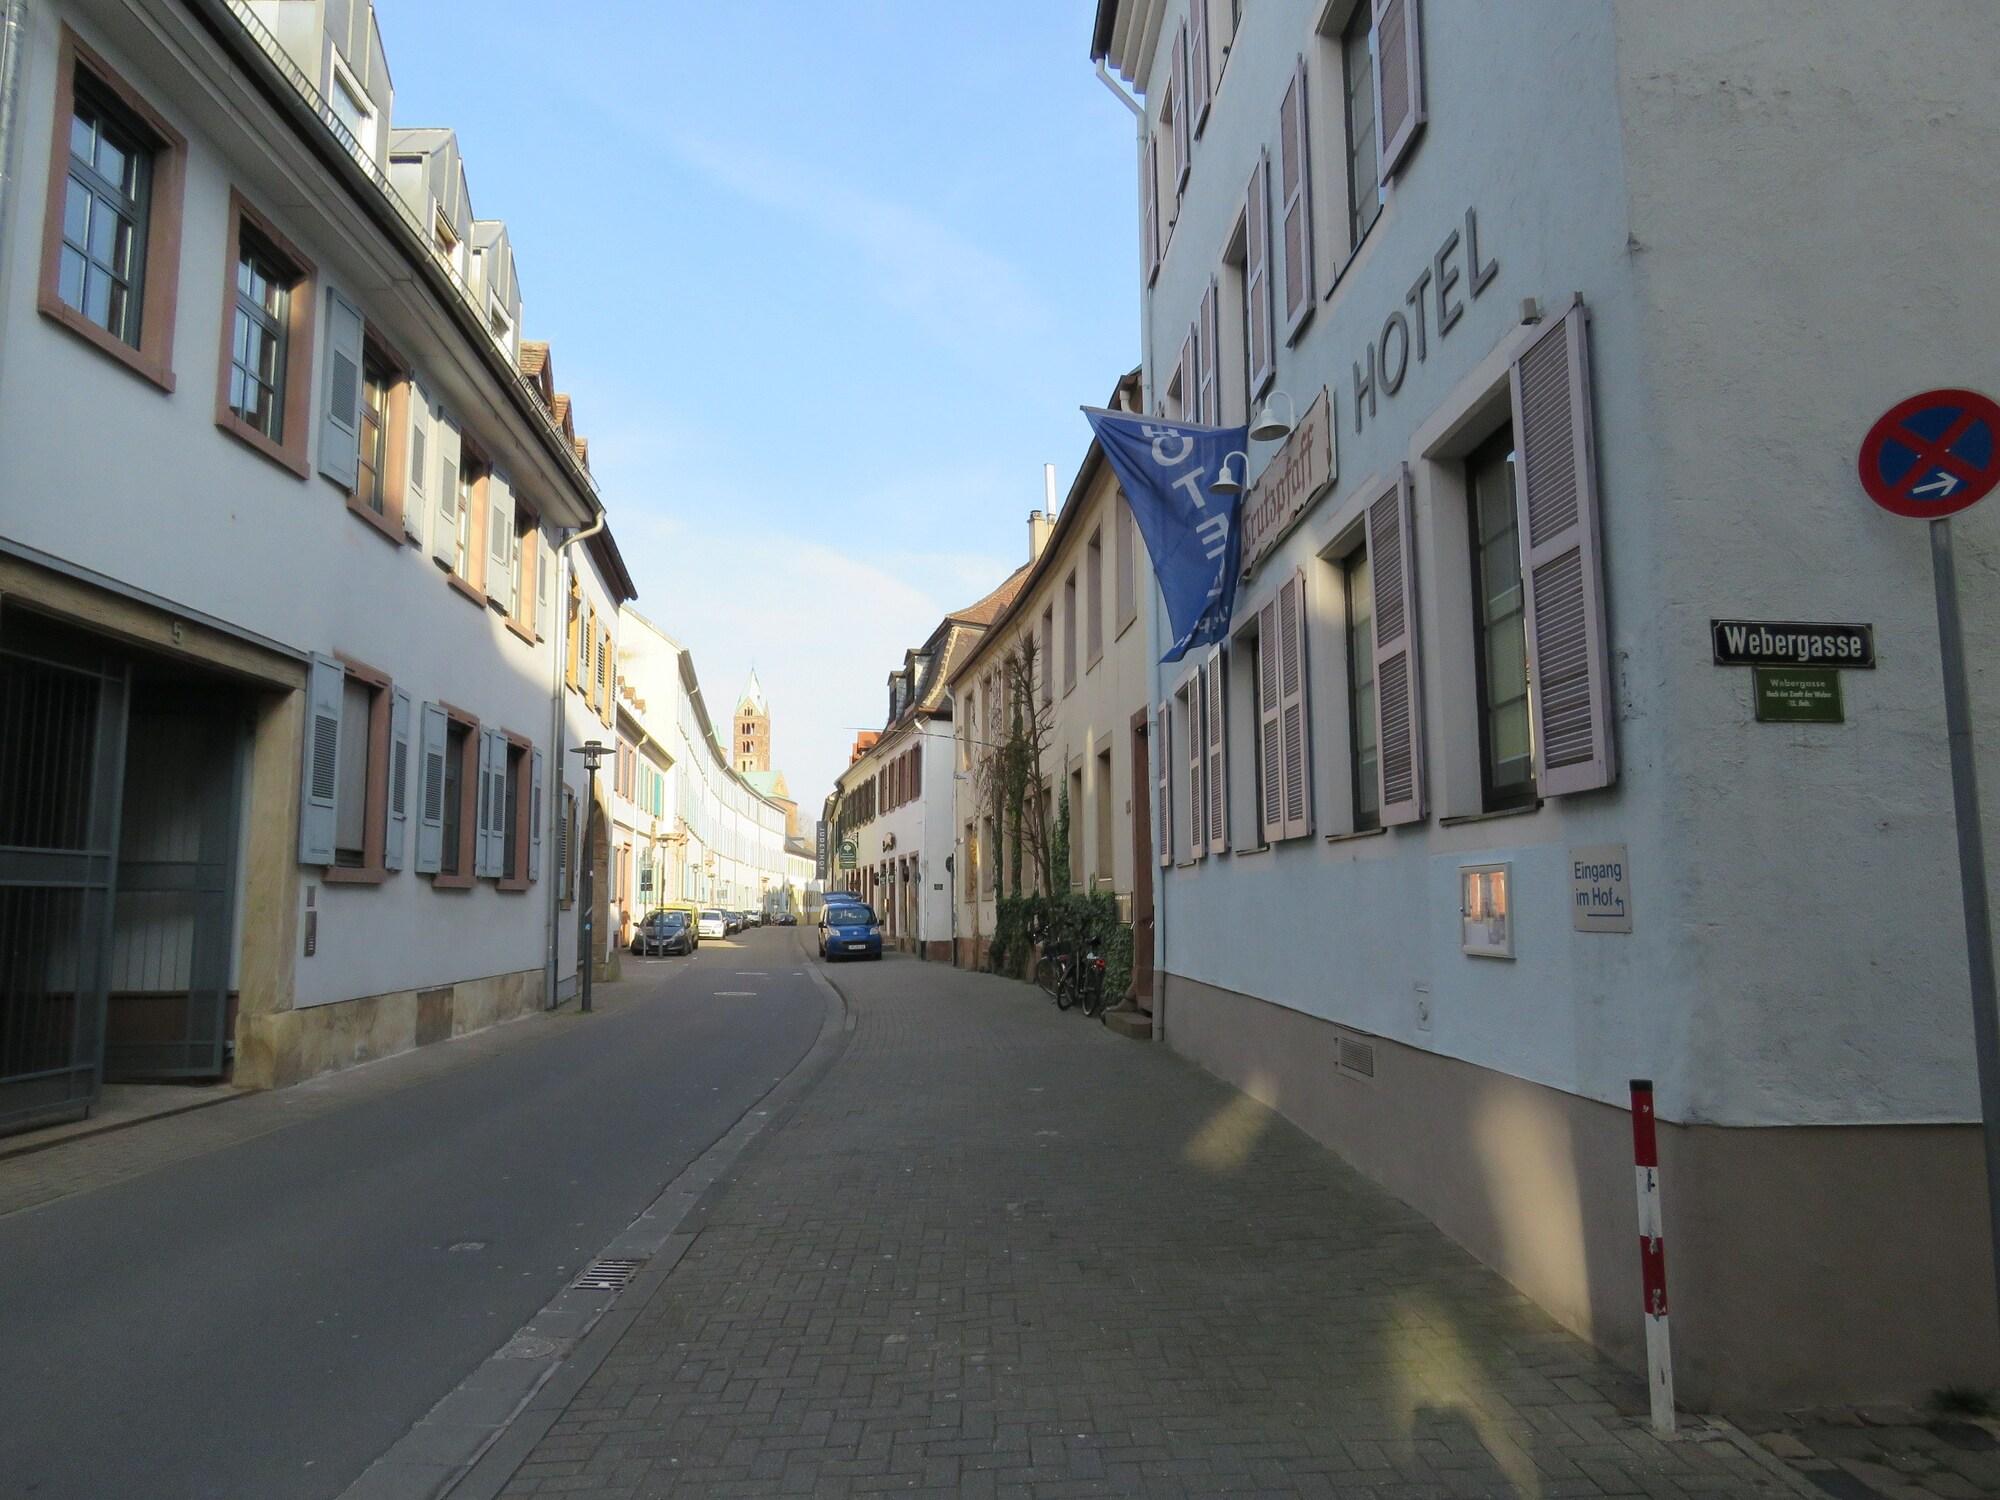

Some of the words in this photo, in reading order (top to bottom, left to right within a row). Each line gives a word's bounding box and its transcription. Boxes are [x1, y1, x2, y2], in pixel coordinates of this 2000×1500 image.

[1352, 205, 1500, 435] HOTEL
[172, 622, 184, 645] 5
[1723, 625, 1862, 662] Webergasse
[1769, 678, 1826, 688] Webergasse
[1575, 861, 1622, 882] Eingang
[1575, 887, 1590, 906] im
[1592, 887, 1613, 906] Hof
